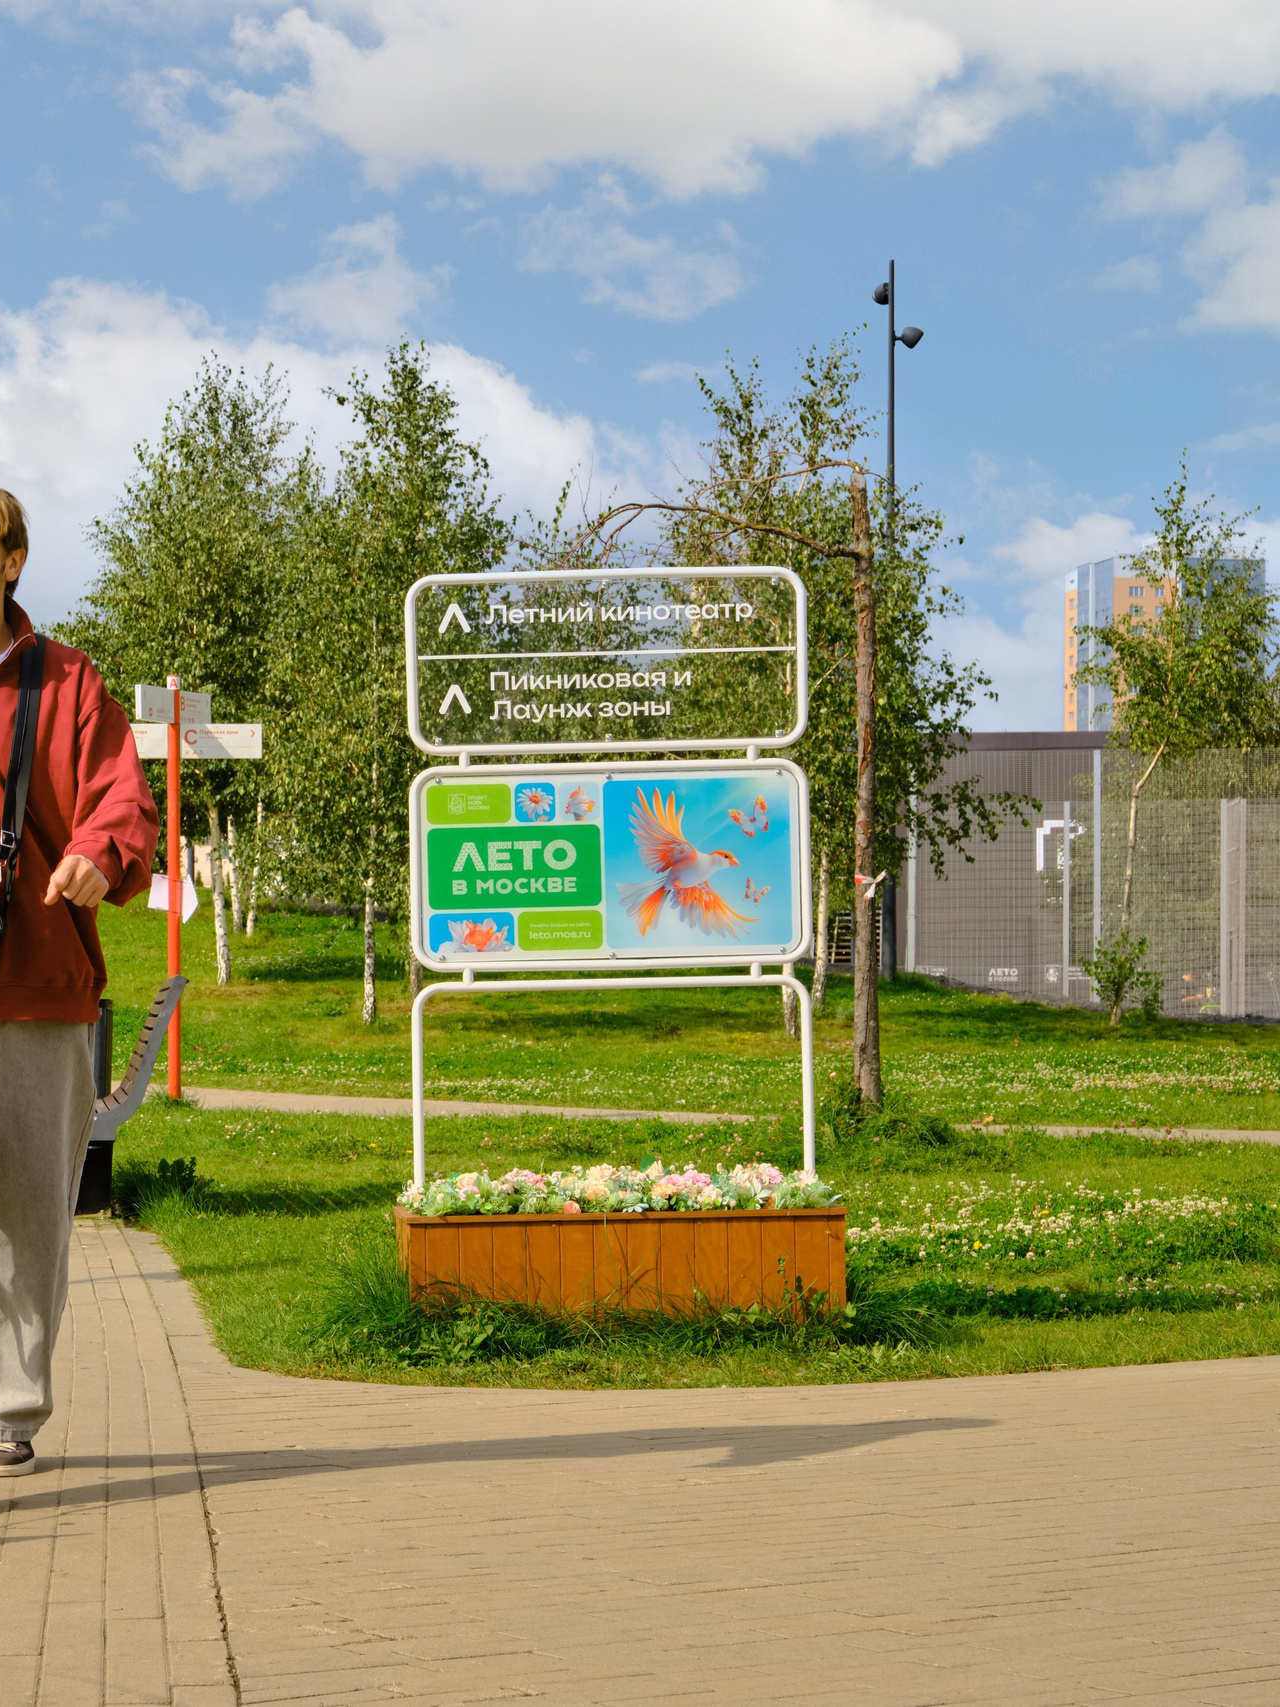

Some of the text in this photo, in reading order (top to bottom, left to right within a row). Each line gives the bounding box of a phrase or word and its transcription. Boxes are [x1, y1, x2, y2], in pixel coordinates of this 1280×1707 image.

[485, 602, 754, 625] Летний кинотеатр
[489, 671, 692, 691] Пикниковая и
[489, 700, 671, 723] Лаунж зоны
[452, 839, 577, 872] ЛЕТО
[452, 876, 577, 895] В МОСКВЕ
[529, 931, 591, 939] leto.mos.ru
[989, 968, 1018, 976] ЛЕТО
